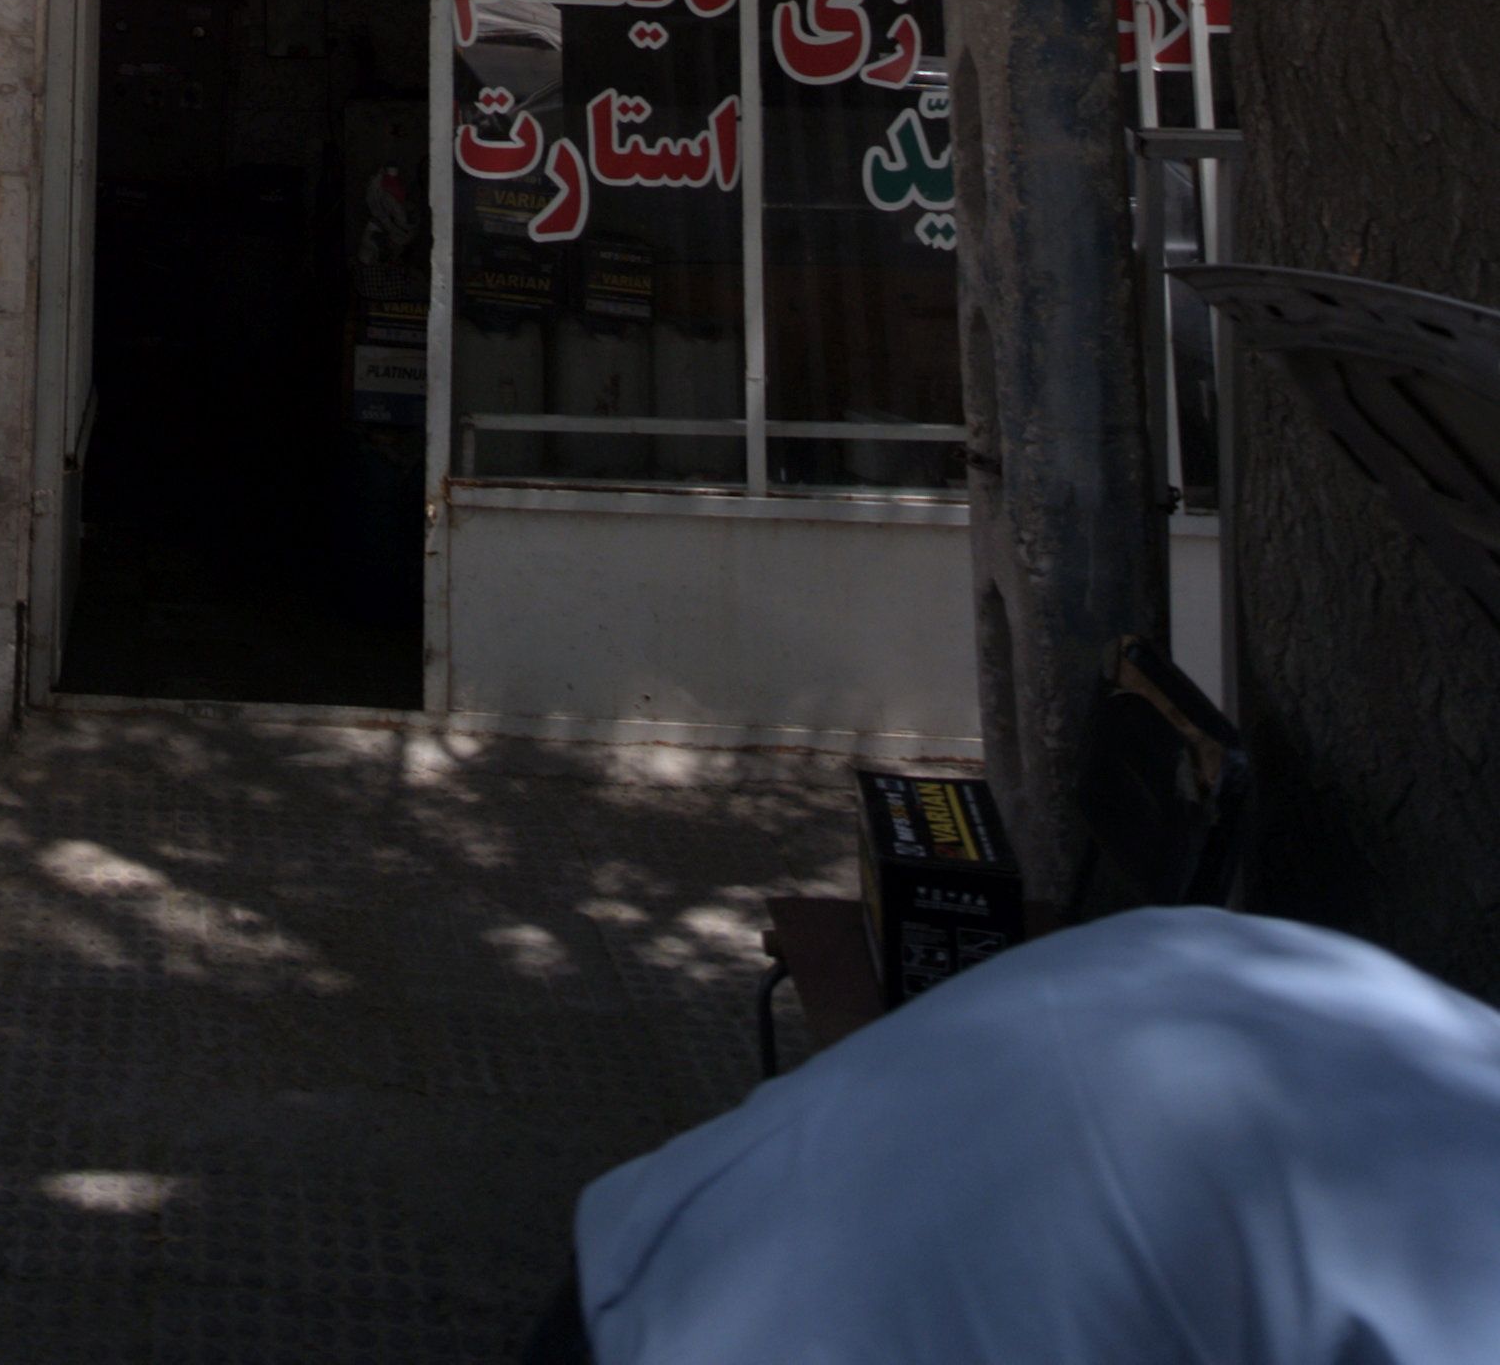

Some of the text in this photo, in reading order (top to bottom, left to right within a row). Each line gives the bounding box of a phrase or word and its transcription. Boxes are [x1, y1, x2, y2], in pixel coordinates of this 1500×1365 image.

[453, 86, 742, 243] استارت
[493, 188, 551, 209] VARIA
[484, 269, 550, 292] VARIAN
[601, 272, 651, 290] VARIAN
[915, 780, 962, 844] VARIAN
